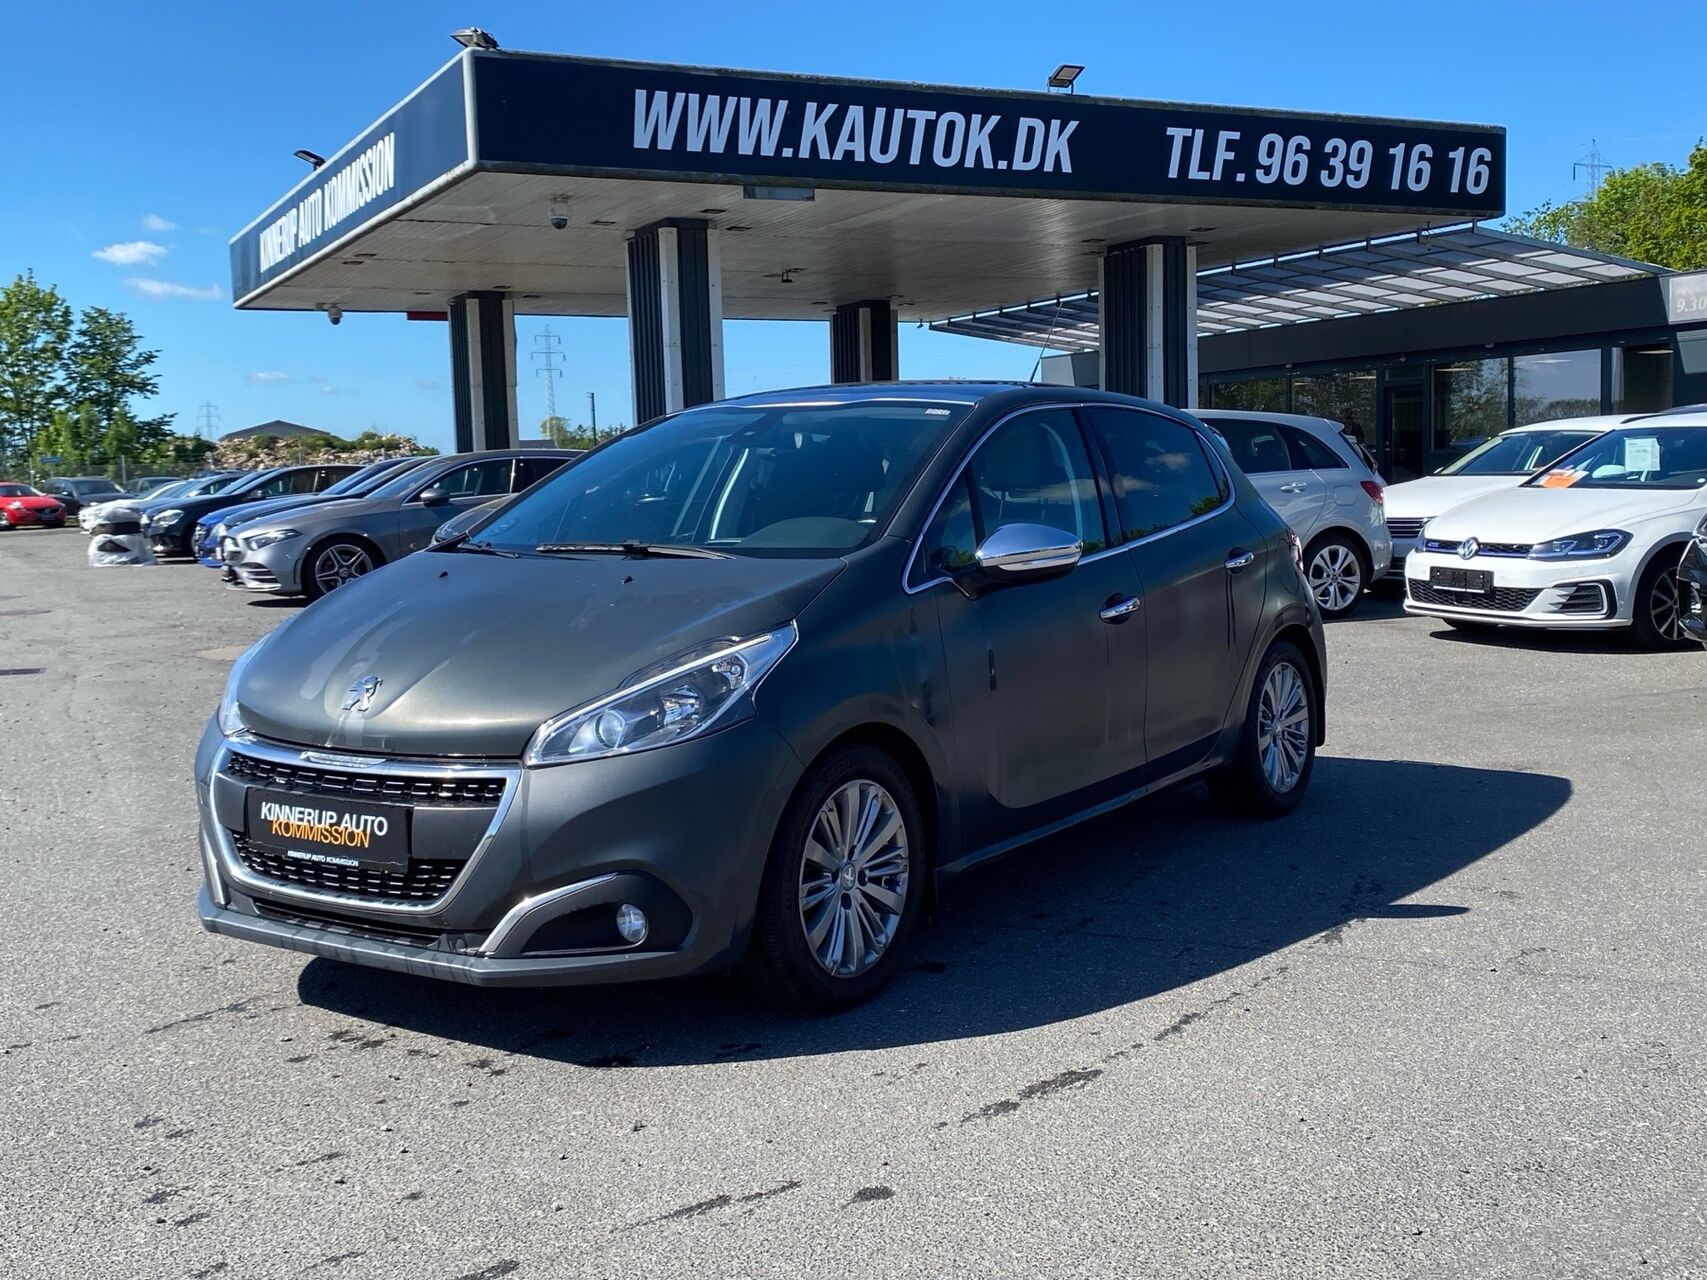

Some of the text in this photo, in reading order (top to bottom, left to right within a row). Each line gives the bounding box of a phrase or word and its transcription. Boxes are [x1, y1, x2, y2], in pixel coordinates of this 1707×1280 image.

[633, 88, 1080, 174] WWW.KAUTOK.DK
[1166, 126, 1492, 195] TLF. 96 39 16 16
[259, 132, 395, 273] KINNERUP AUTO KOMMISSION
[261, 801, 388, 836] KINNERUP AUTO
[271, 819, 371, 848] KOMMISSION
